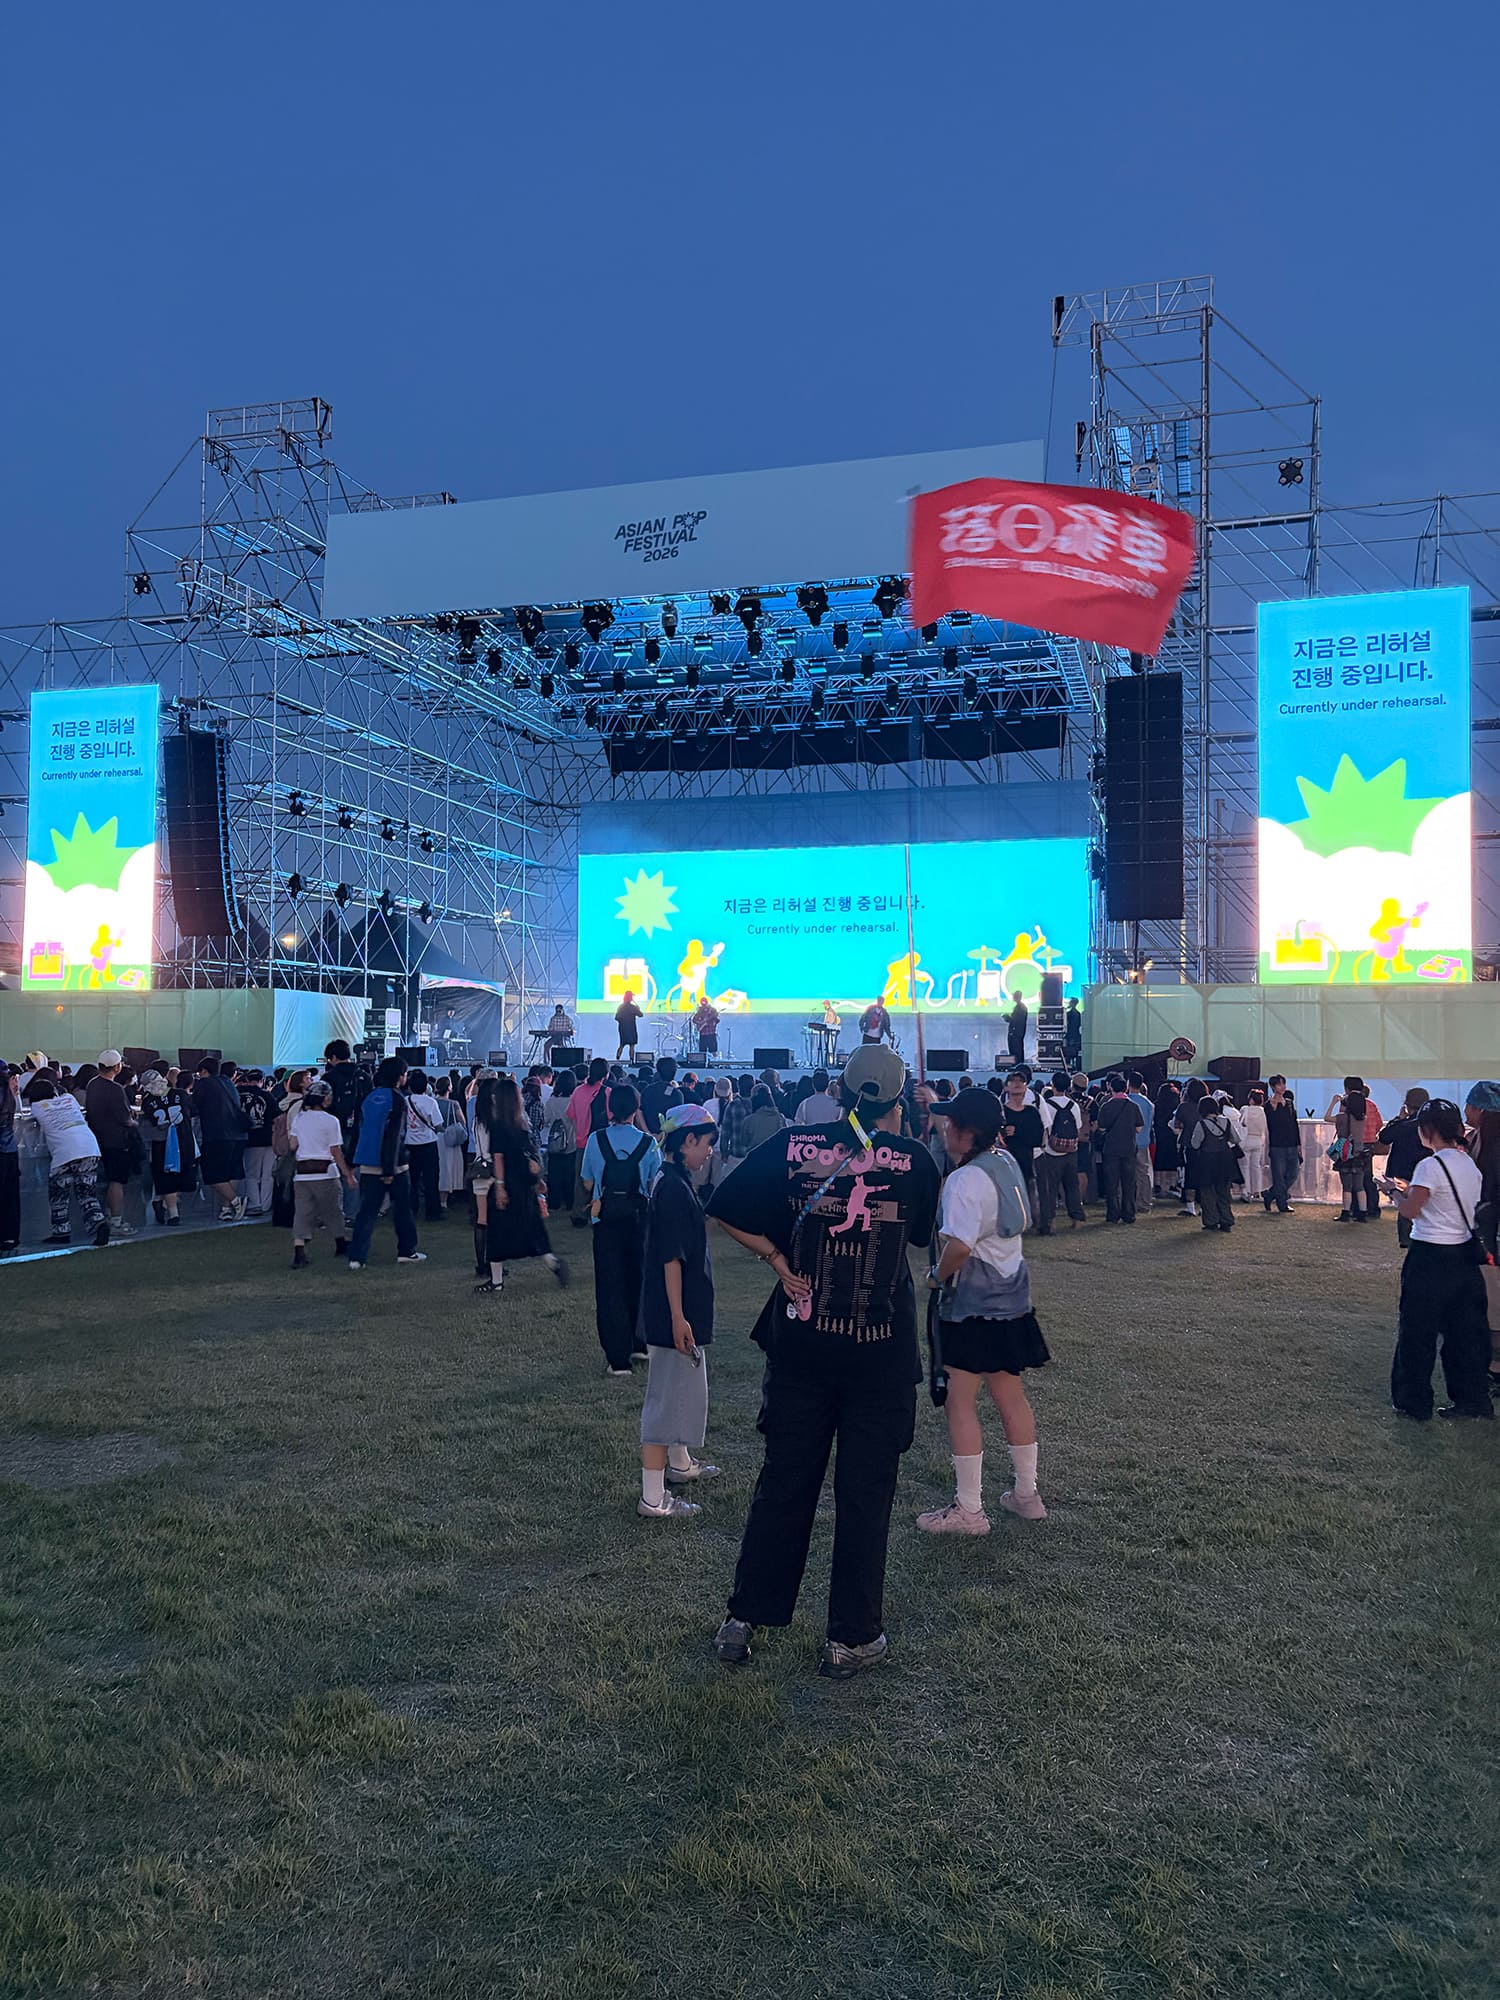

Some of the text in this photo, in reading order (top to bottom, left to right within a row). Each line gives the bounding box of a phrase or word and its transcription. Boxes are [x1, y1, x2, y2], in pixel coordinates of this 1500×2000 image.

[615, 518, 666, 540] ASIAN
[624, 528, 698, 553] FESTIVAL
[643, 546, 679, 563] 2026
[1294, 630, 1431, 660] 지금은 리허설
[1292, 660, 1433, 689] 진행 중입니다.
[1279, 693, 1447, 715] Currently under rehearsal.
[51, 717, 135, 738] 지금은 리허설
[50, 740, 136, 761] 진행 중입니다.
[41, 767, 144, 781] Currently under rehearsal.
[723, 894, 926, 914] 지금은 리허설 진행 중입니다.
[747, 922, 899, 935] Currently under rehearsal.
[789, 1134, 826, 1142] CHROMA
